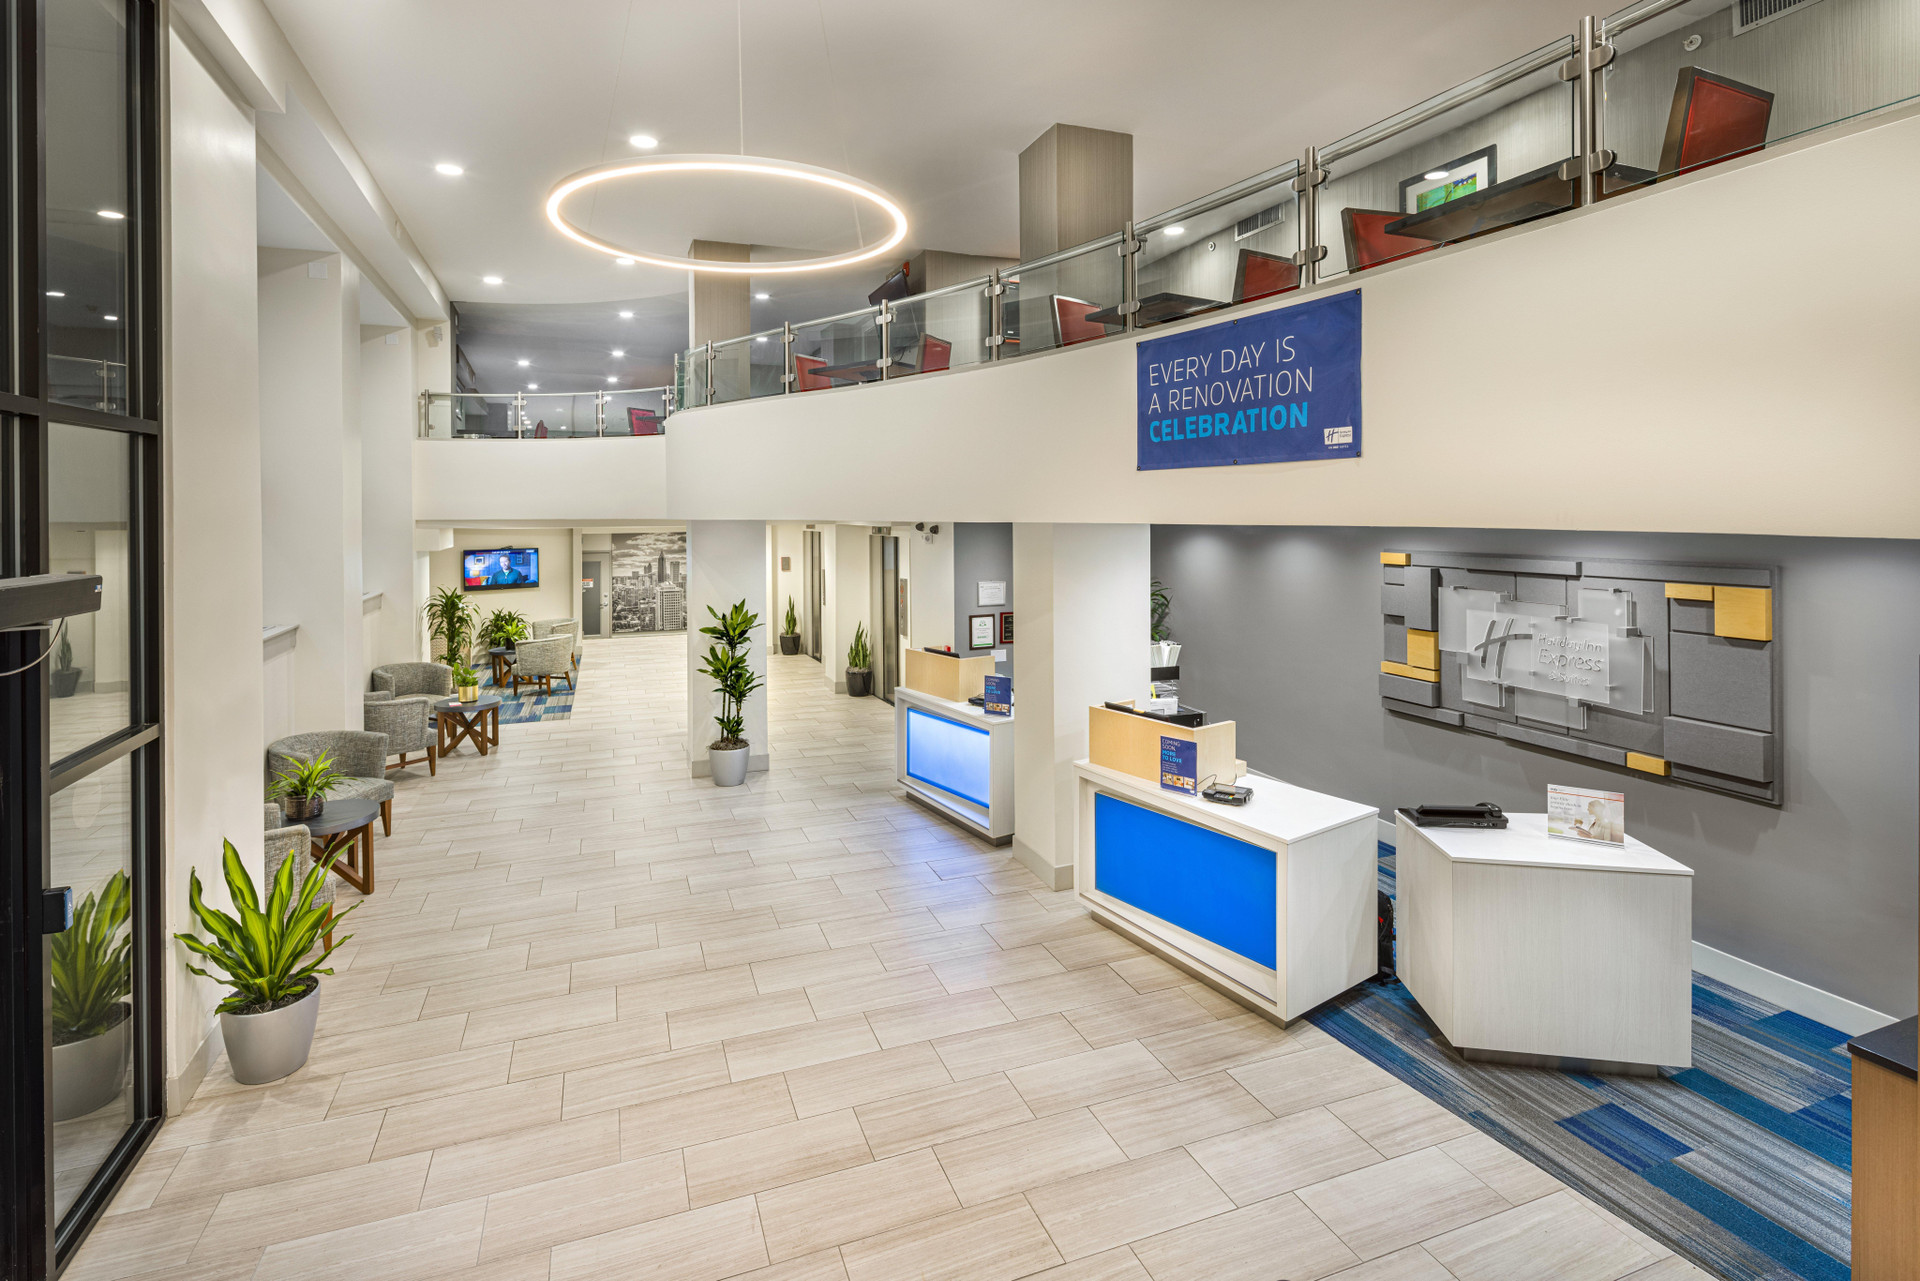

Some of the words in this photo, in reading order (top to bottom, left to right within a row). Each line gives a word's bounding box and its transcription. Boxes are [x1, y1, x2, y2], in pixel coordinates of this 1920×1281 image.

[1149, 353, 1213, 387] EVERY
[1221, 341, 1266, 374] DAY
[1275, 335, 1296, 364] IS
[1148, 392, 1162, 415] A
[1168, 366, 1313, 412] RENOVATION
[1149, 401, 1308, 443] CELEBRATION
[1538, 648, 1603, 673] Express
